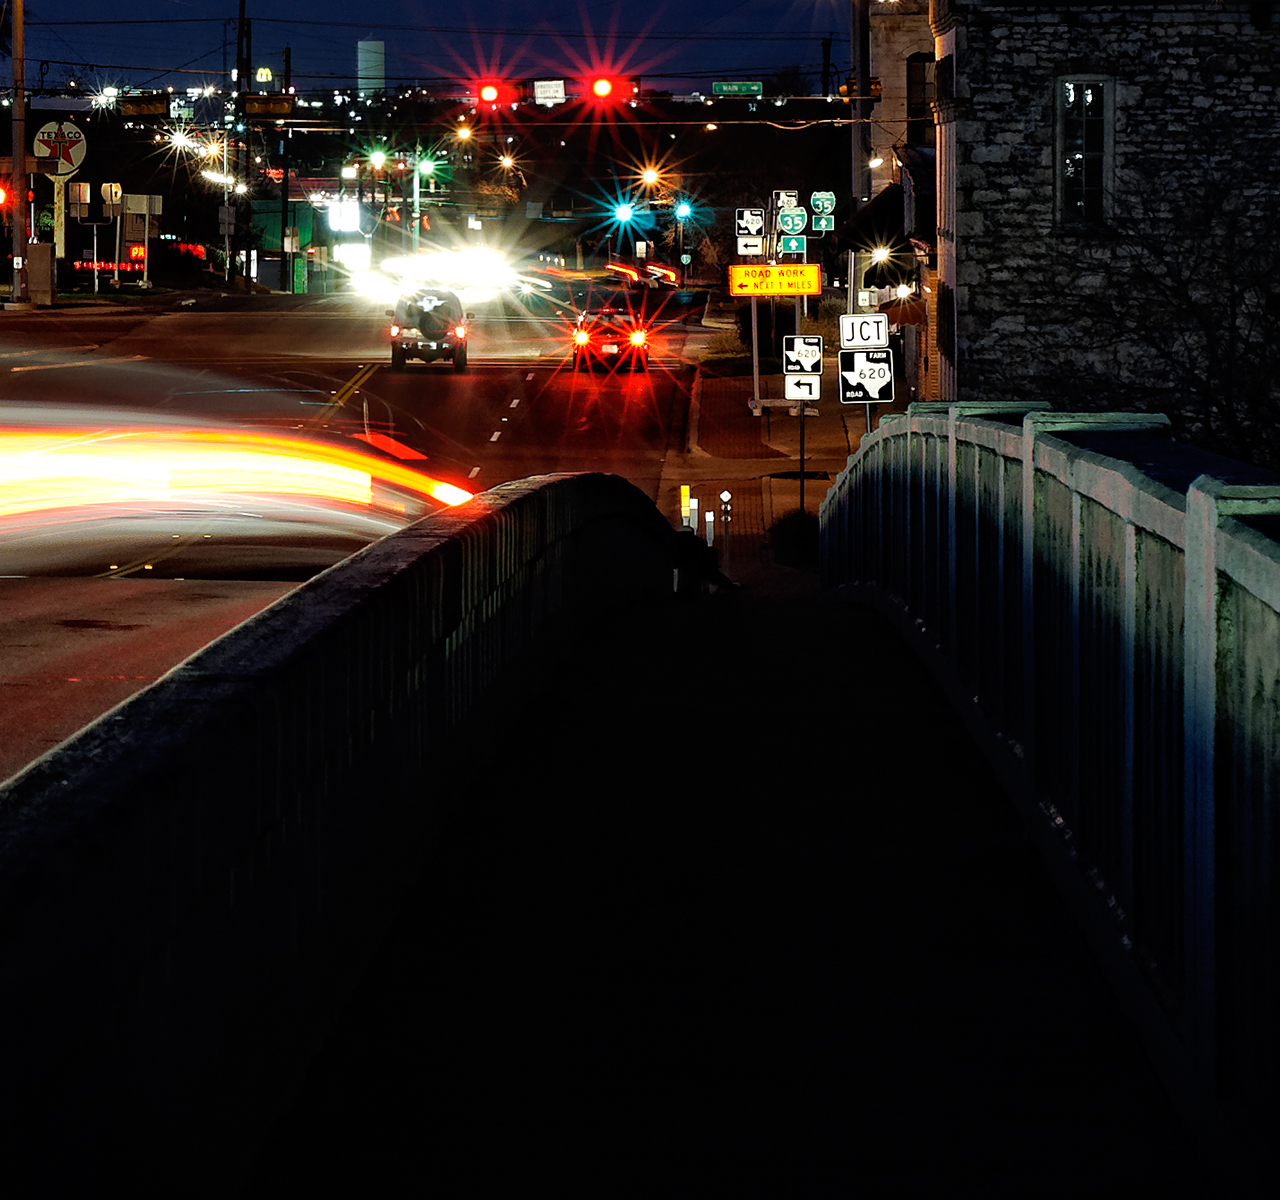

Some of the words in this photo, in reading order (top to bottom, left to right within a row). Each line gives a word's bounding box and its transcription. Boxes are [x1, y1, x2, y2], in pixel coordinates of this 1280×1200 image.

[40, 131, 81, 139] TEXACO
[815, 200, 832, 212] 35
[783, 216, 803, 230] 35
[744, 269, 772, 278] ROAD
[778, 268, 806, 278] WORK
[753, 281, 774, 290] NEXT
[779, 281, 783, 289] 1
[787, 280, 812, 289] MILES
[845, 320, 883, 342] JCT
[797, 349, 817, 358] 620
[859, 367, 886, 380] 620
[845, 390, 864, 398] ROAD
